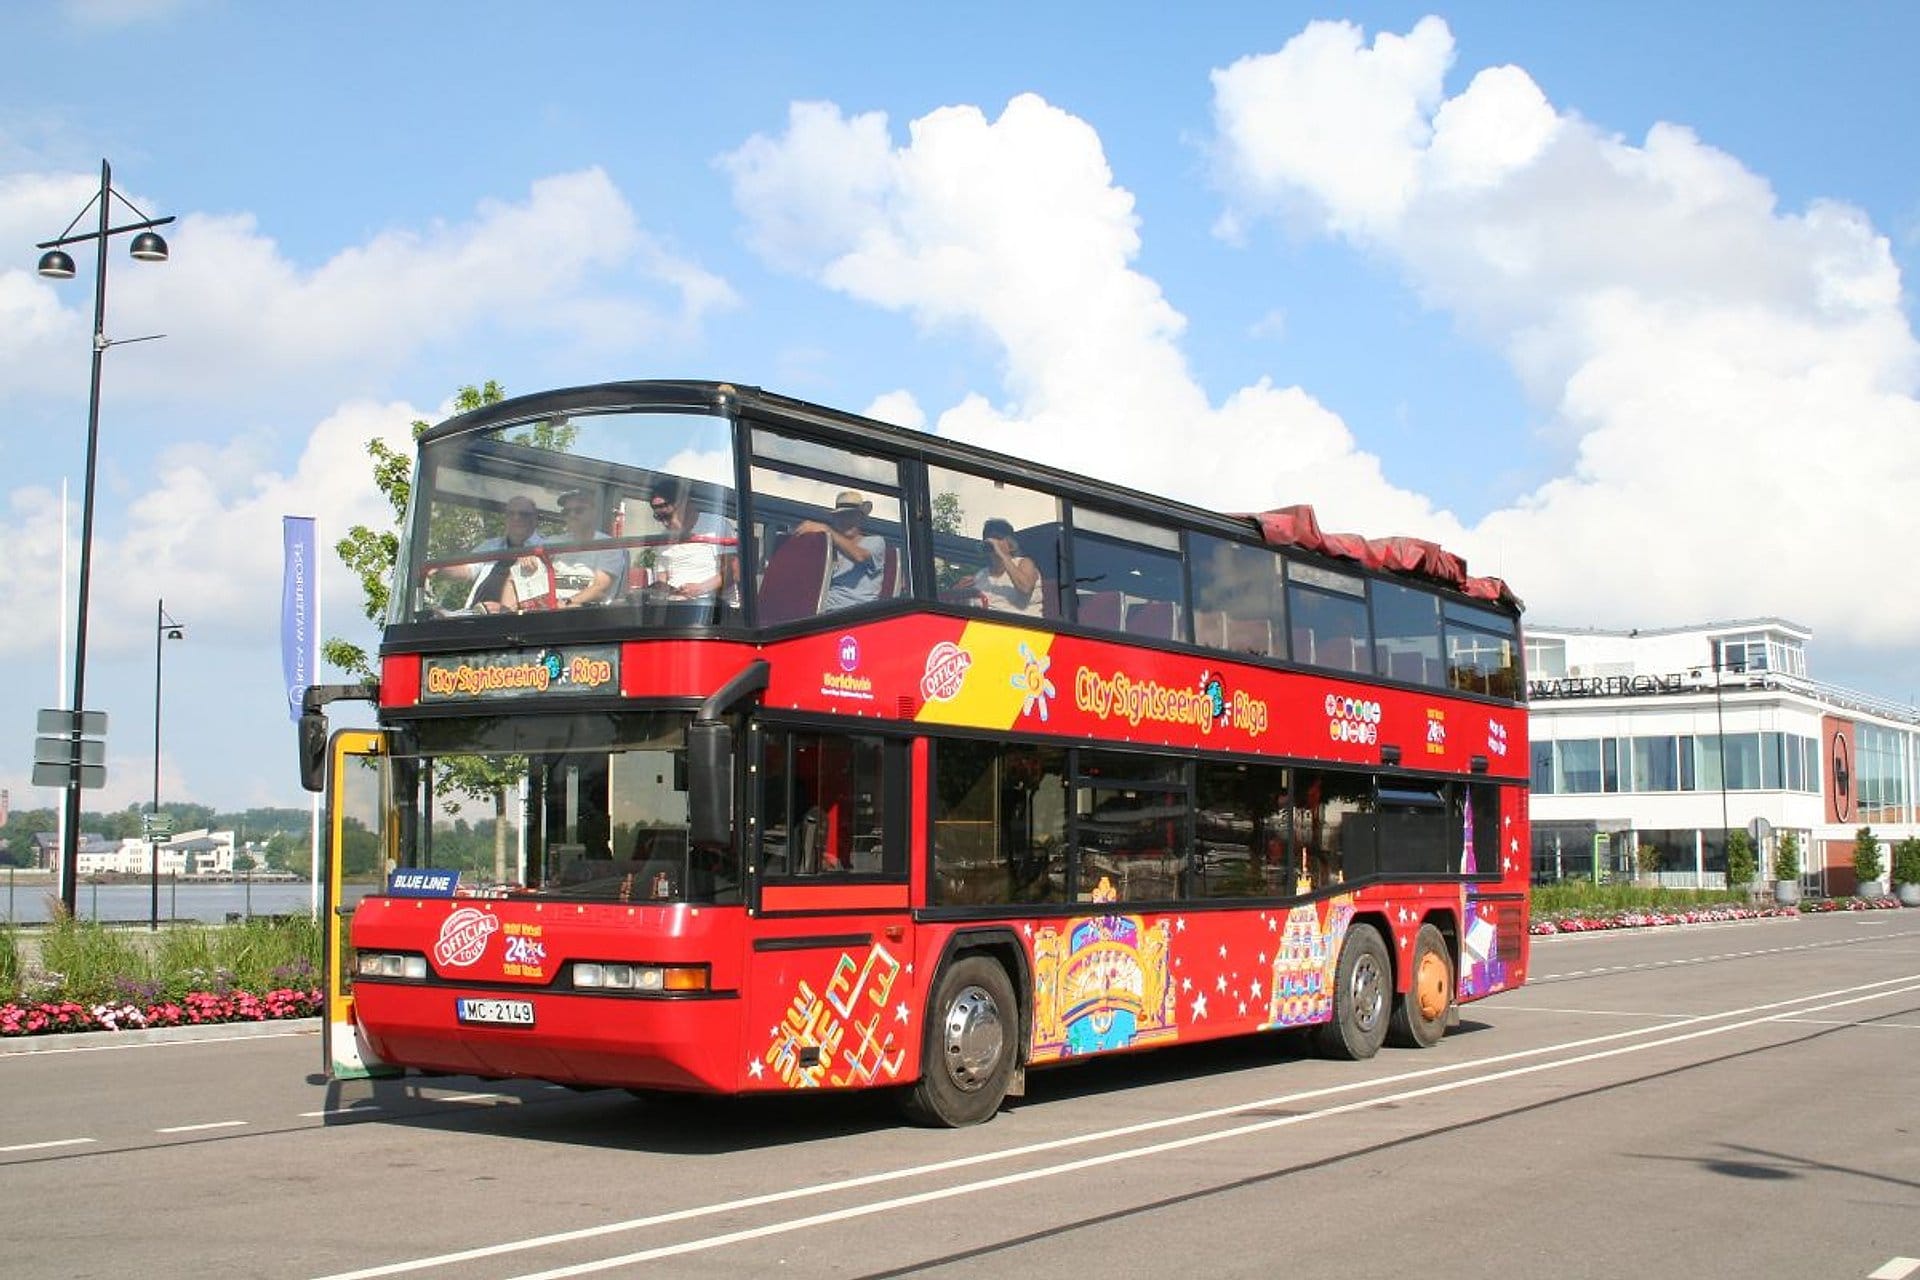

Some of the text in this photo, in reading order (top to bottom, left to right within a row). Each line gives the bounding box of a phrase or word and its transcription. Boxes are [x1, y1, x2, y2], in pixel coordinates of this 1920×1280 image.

[571, 656, 611, 686] Riga
[926, 655, 970, 693] OFFICIAL
[1233, 689, 1268, 736] Riga
[394, 874, 450, 890] BLUE LINE
[441, 919, 494, 958] OFFICIAL
[460, 941, 484, 960] TOUR
[505, 936, 526, 962] 24
